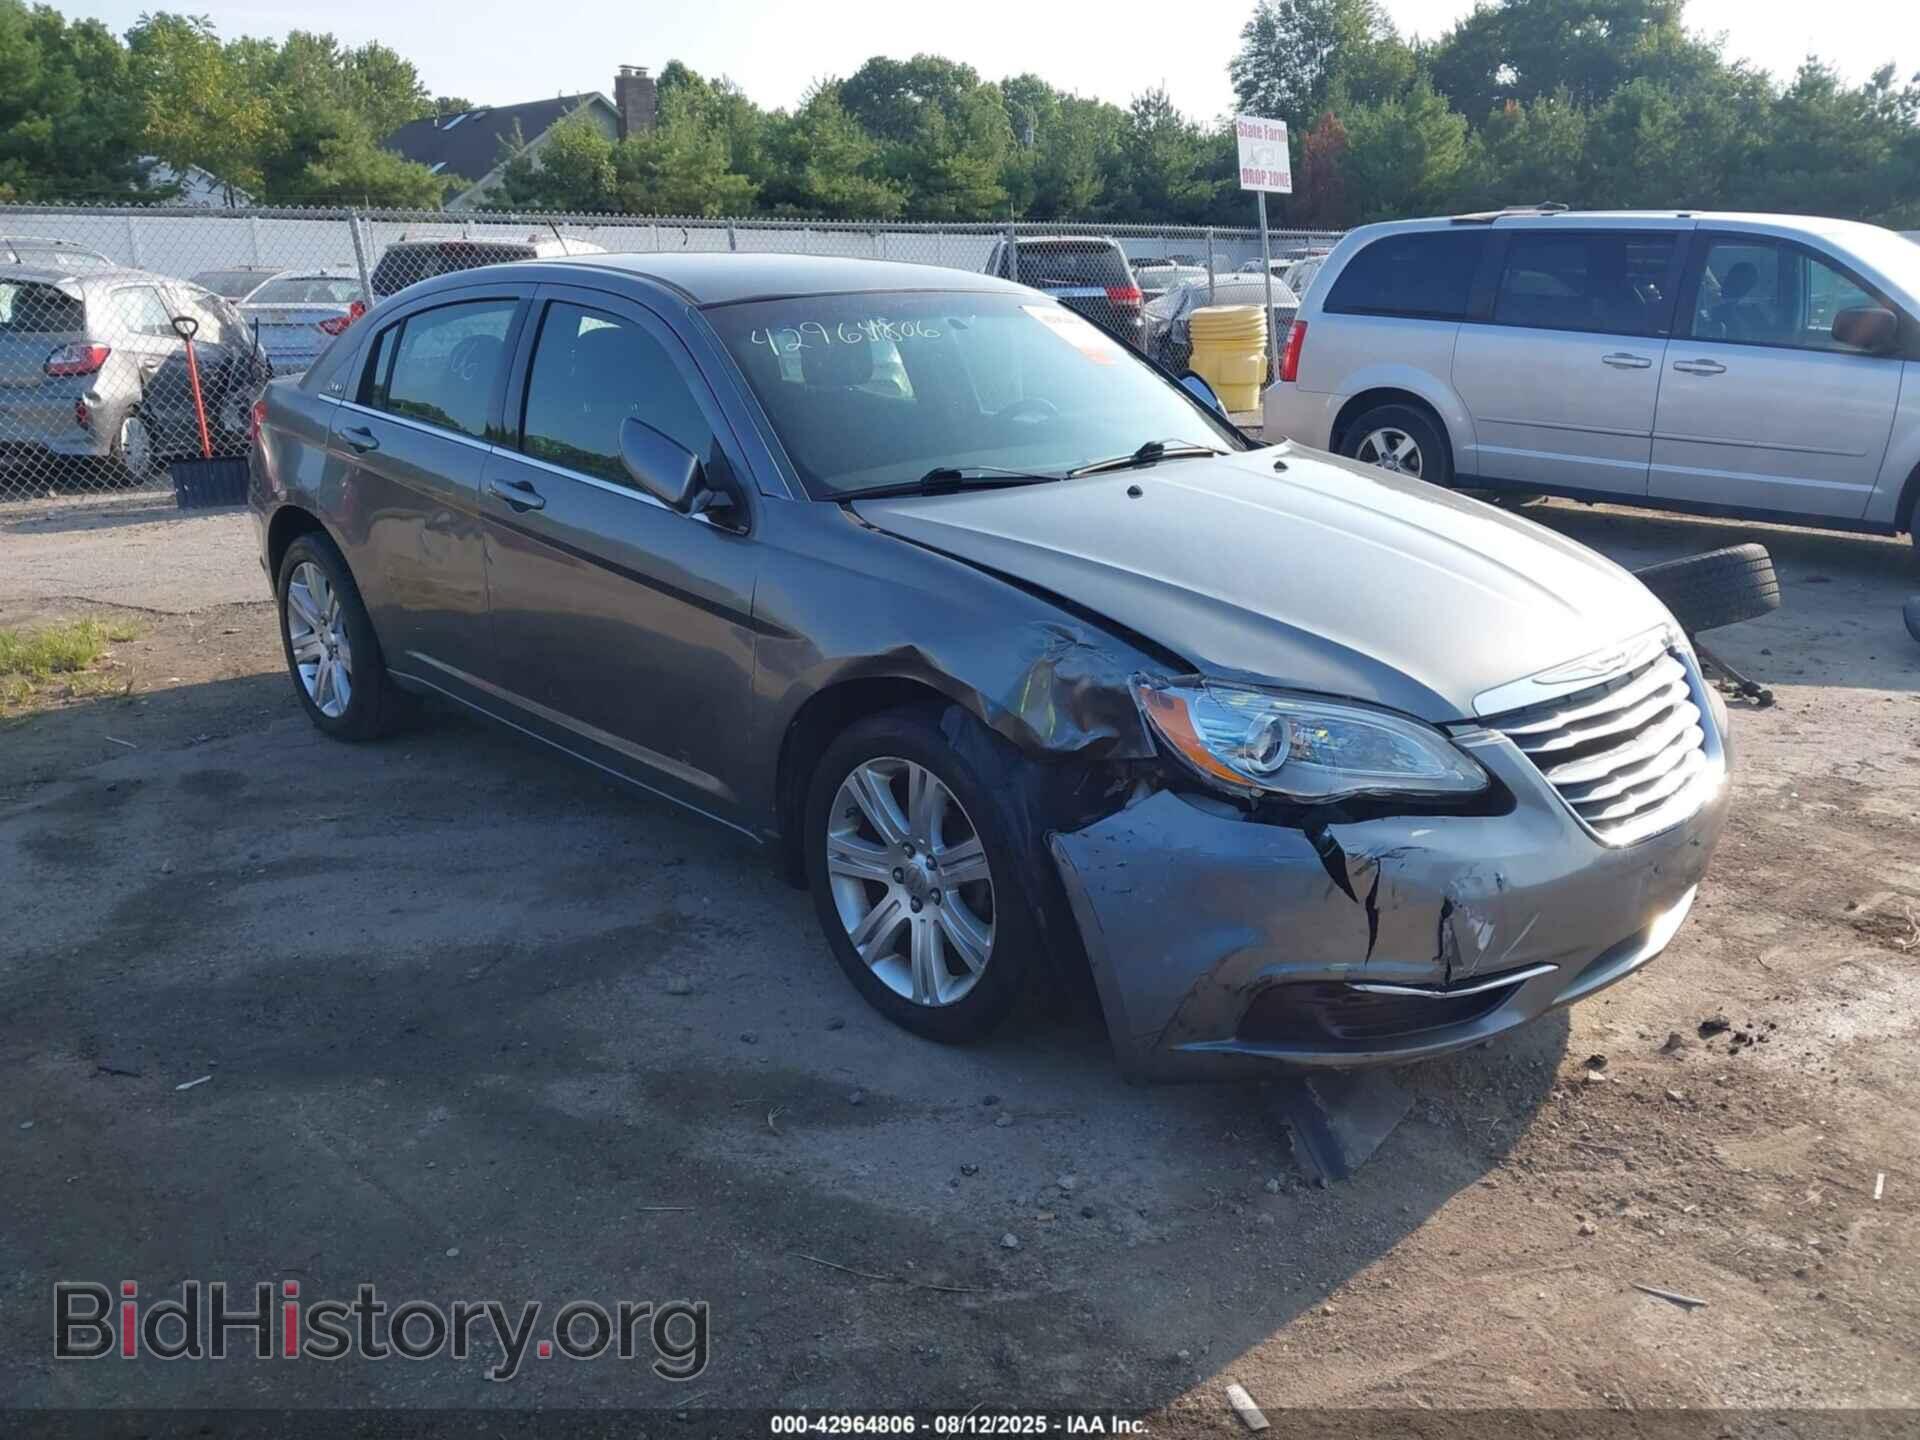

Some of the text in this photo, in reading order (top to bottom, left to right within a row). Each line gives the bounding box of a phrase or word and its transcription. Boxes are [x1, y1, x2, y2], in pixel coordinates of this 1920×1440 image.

[1238, 121, 1287, 143] State Farm
[1242, 167, 1290, 188] DROP ZONE
